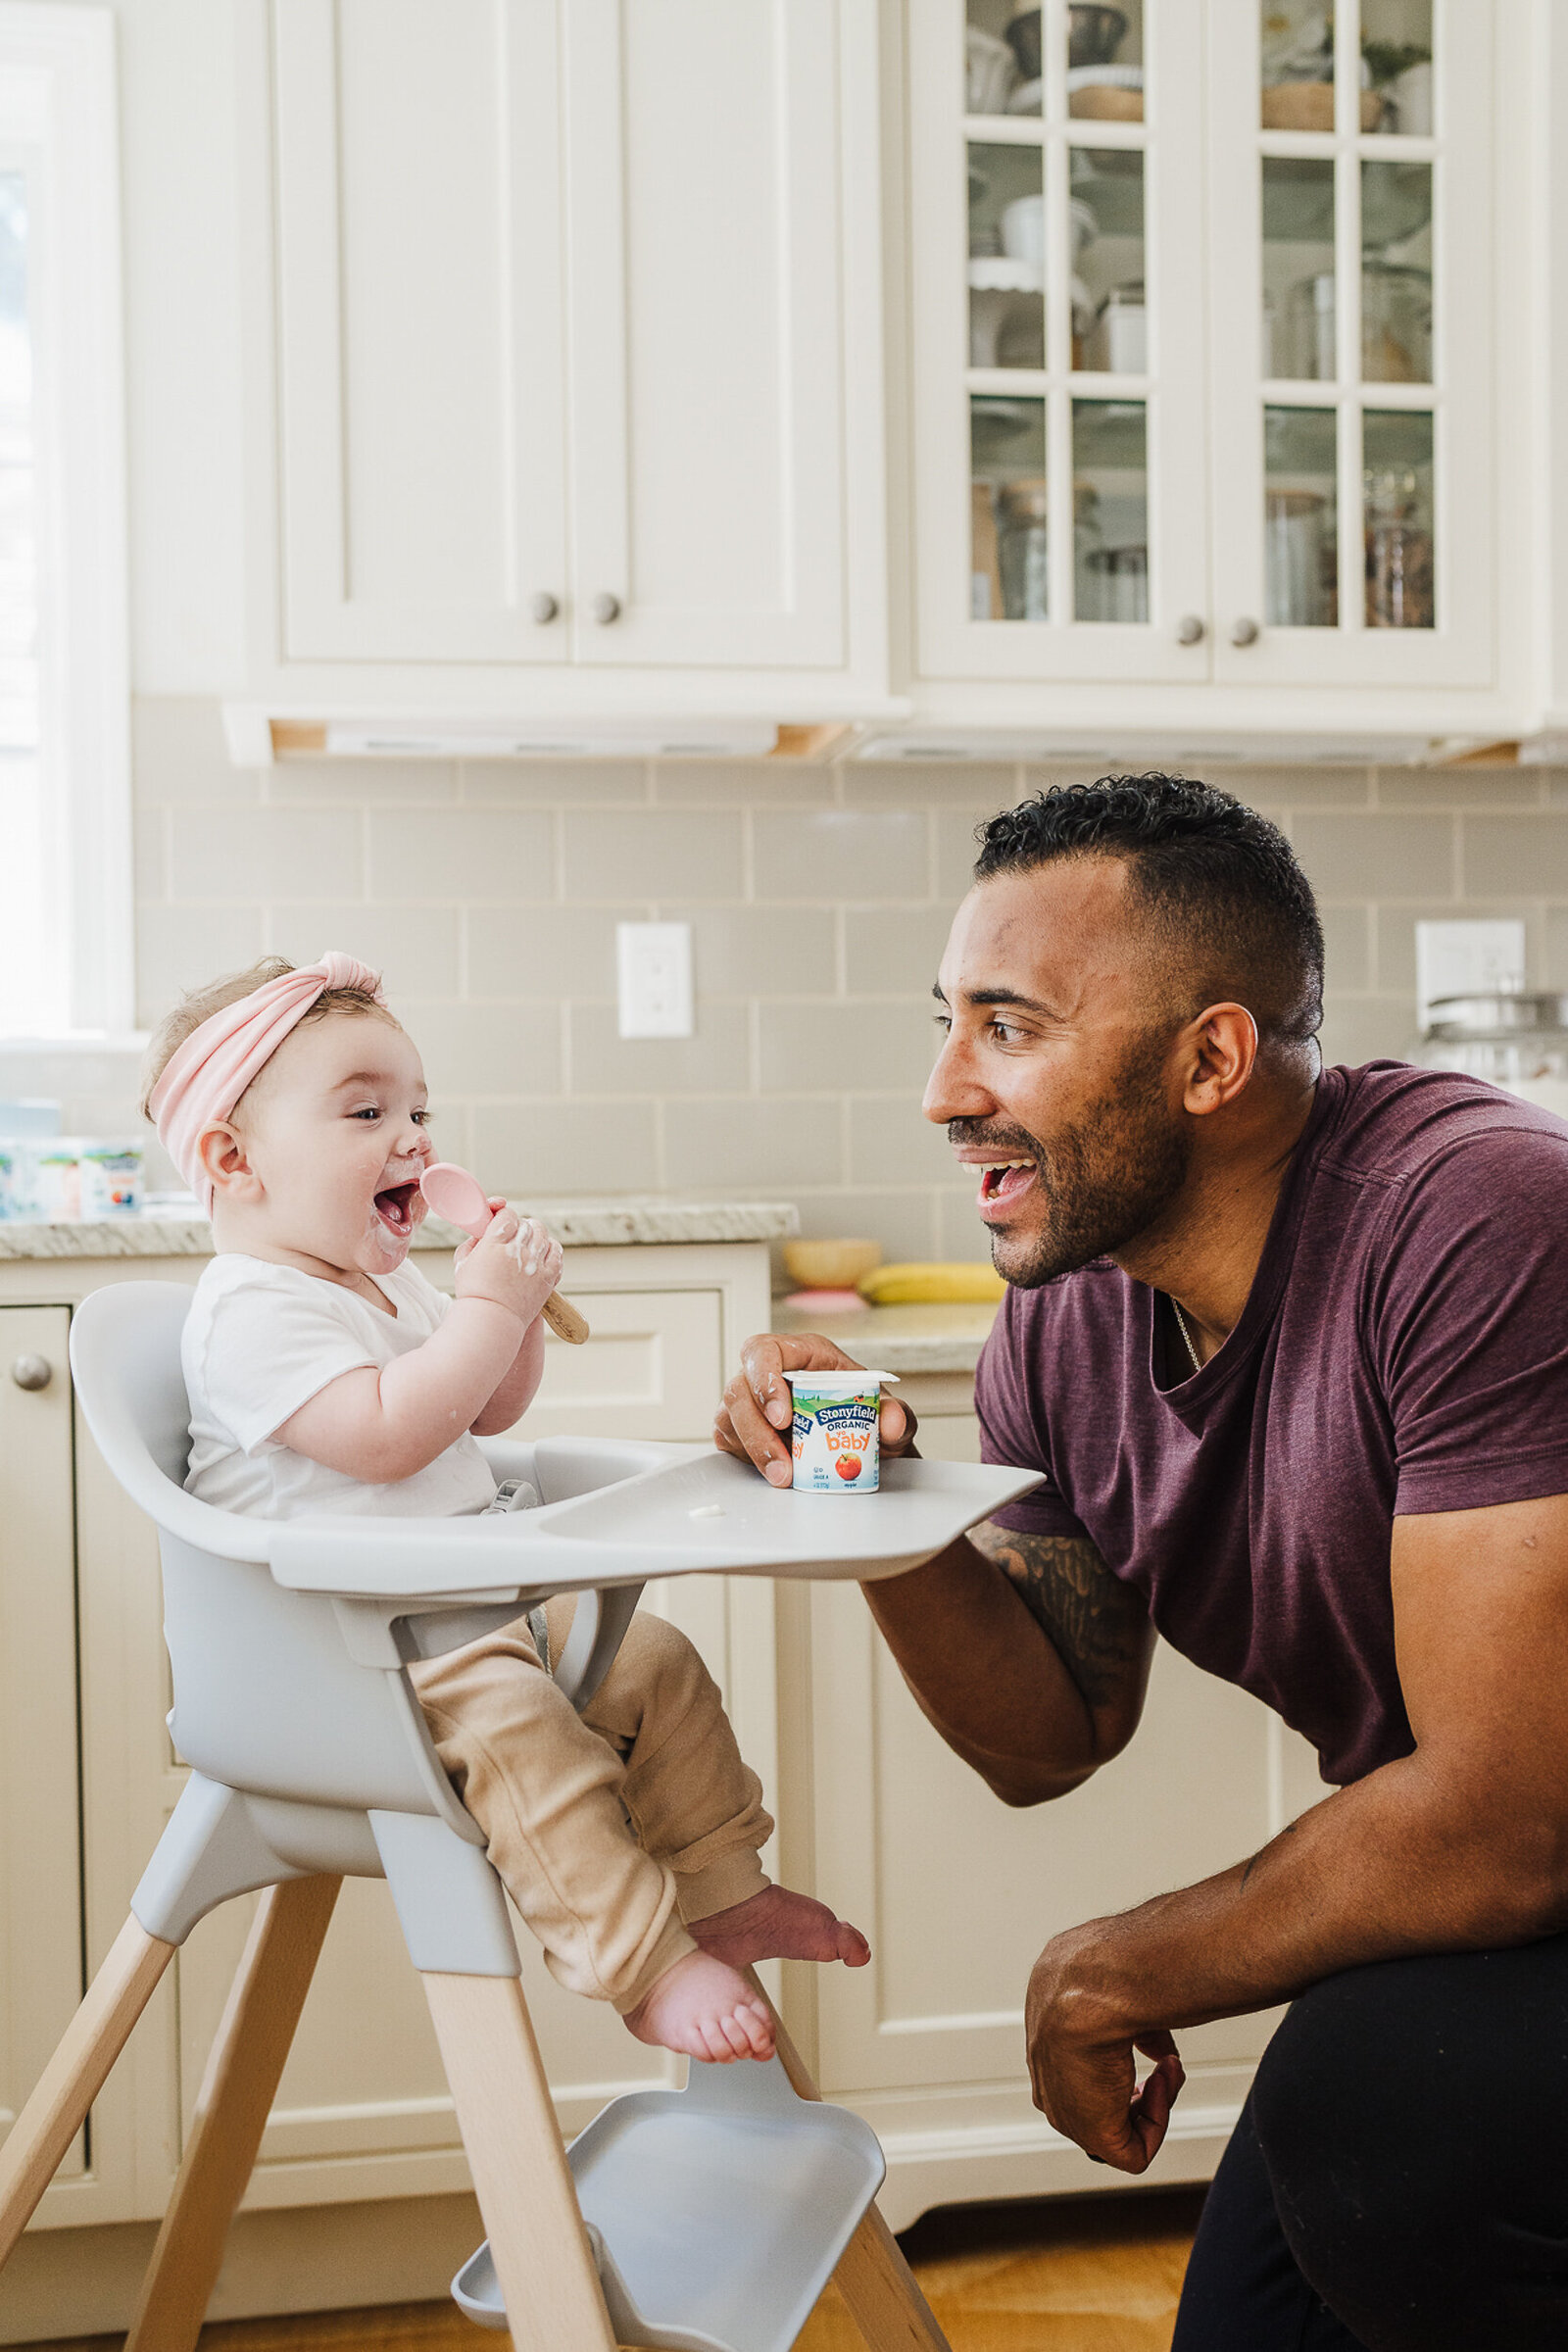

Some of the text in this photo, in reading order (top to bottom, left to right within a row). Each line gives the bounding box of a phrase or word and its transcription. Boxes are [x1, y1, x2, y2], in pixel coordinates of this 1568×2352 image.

[819, 1405, 876, 1422] Stonyfield
[827, 1421, 870, 1431] ORGANIC
[825, 1433, 871, 1451] baby
